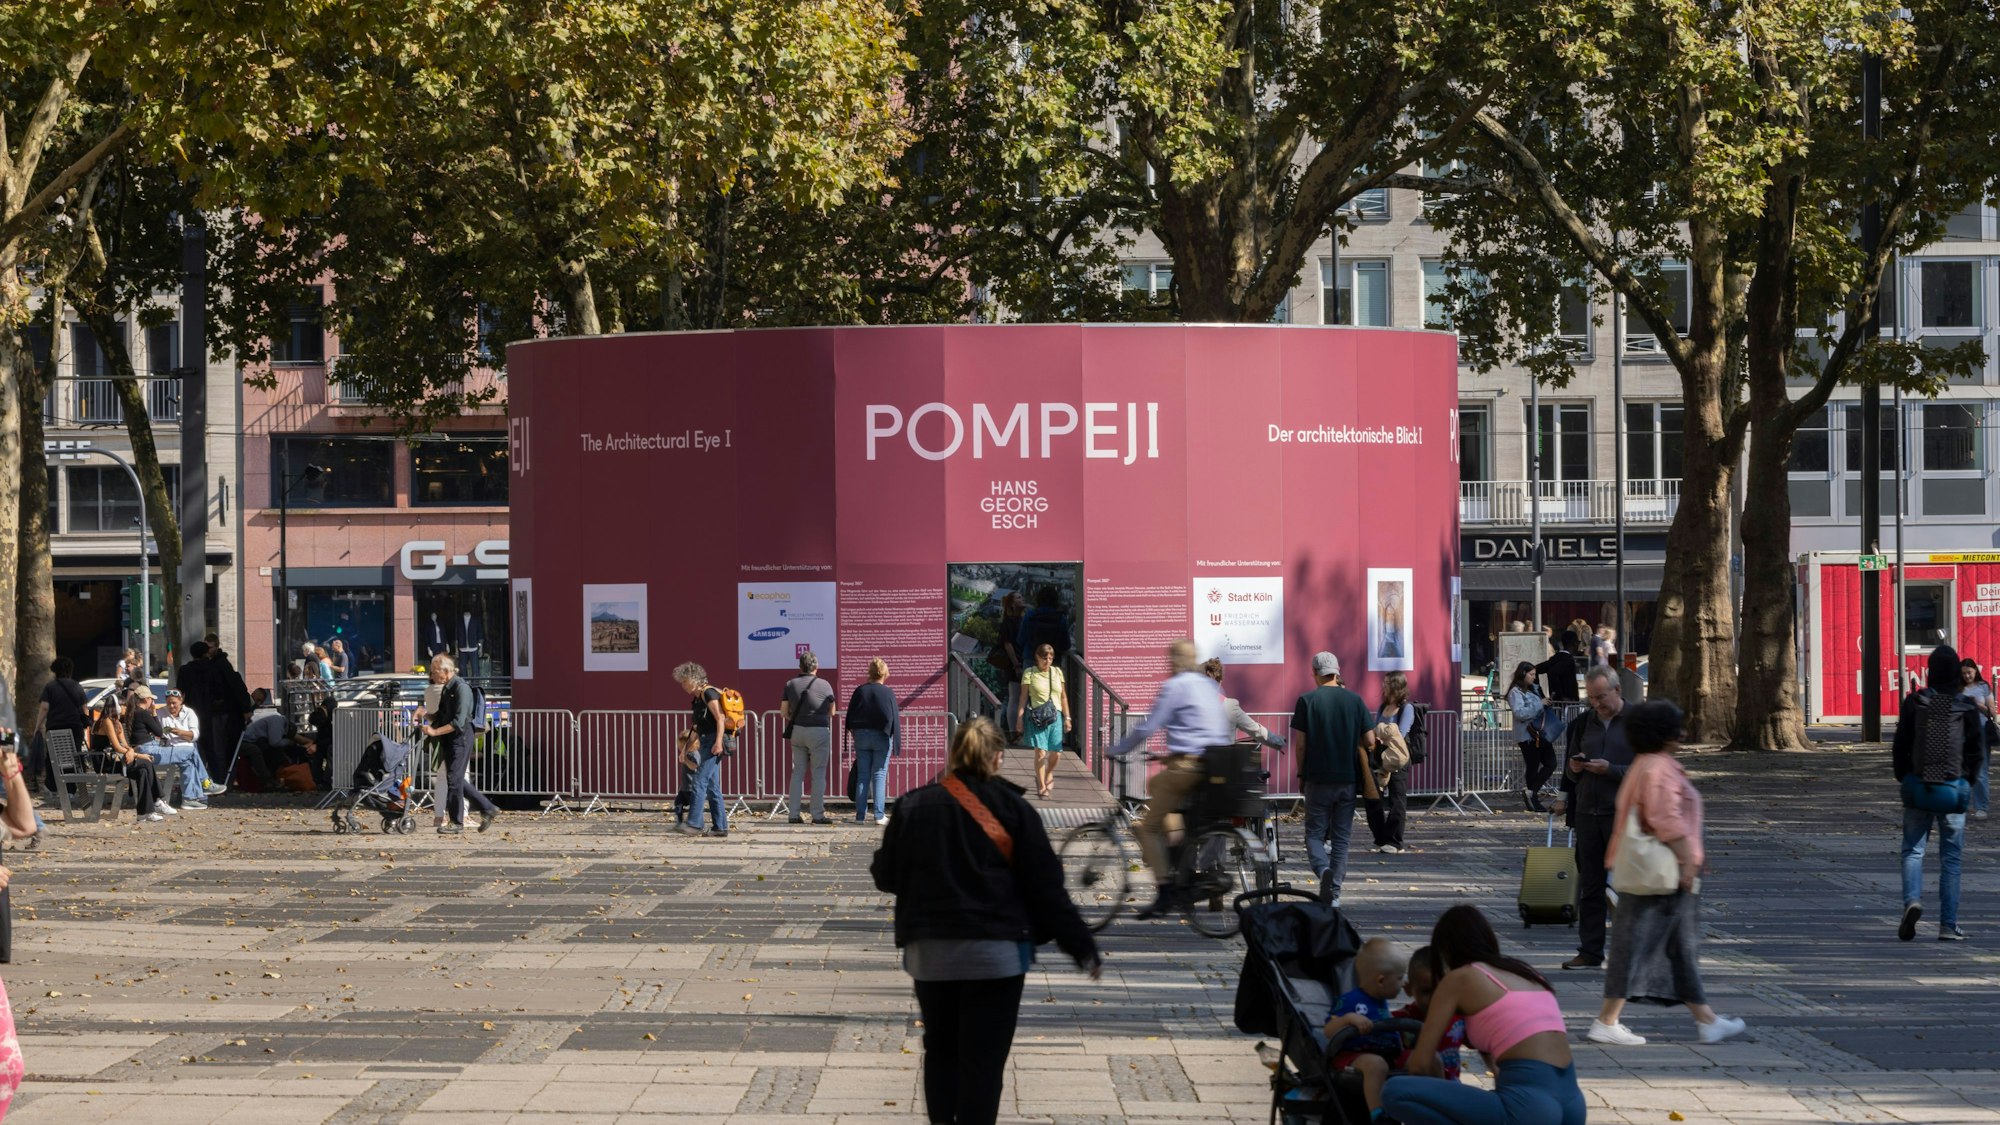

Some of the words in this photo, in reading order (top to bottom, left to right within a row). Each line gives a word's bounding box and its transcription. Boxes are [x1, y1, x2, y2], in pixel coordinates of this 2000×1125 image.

[581, 433, 602, 451] The
[605, 430, 690, 451] Architectural
[694, 430, 721, 452] Eye
[866, 402, 1160, 466] POMPEJI
[1268, 424, 1294, 443] Der
[1297, 424, 1394, 445] architektonische
[1396, 426, 1418, 445] Blick
[508, 416, 530, 478] EJI
[991, 480, 1038, 496] HANS
[980, 497, 1049, 513] GEORG
[991, 514, 1038, 530] ESCH
[1475, 538, 1618, 559] DANIELS
[1237, 559, 1270, 568] Unterstützung
[754, 591, 791, 601] ecophon
[1228, 592, 1252, 602] Stadt
[1253, 592, 1273, 602] Köln
[1966, 603, 2000, 613] Anlauf
[752, 630, 786, 638] SAMSUNG
[1230, 643, 1263, 651] koelnmesse
